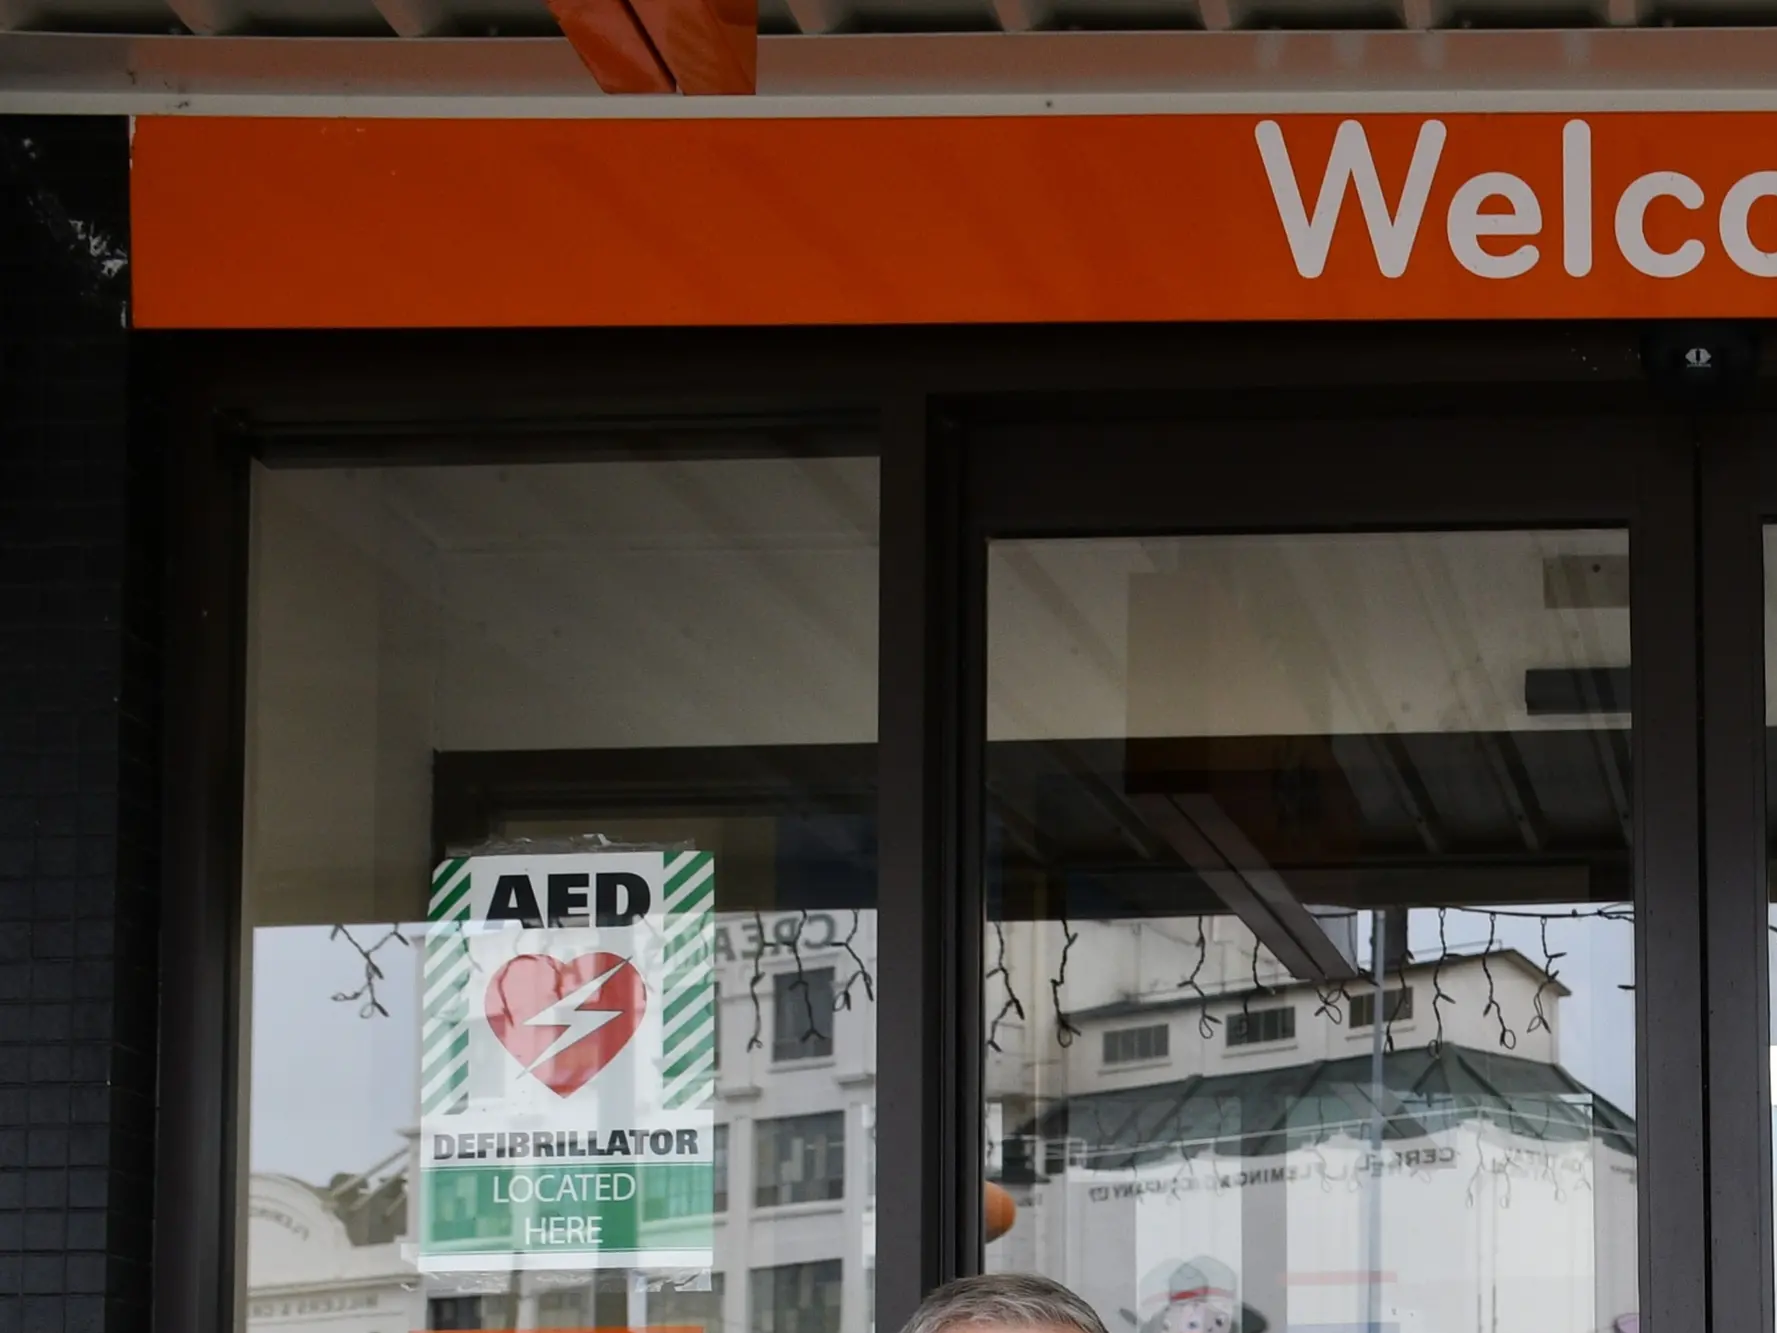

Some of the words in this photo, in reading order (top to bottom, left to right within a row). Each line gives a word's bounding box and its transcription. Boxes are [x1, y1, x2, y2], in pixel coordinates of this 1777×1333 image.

[485, 873, 651, 929] AED
[433, 1129, 699, 1159] DEFIBRILLATOR
[494, 1173, 635, 1203] LOCATED
[525, 1217, 603, 1244] HERE
